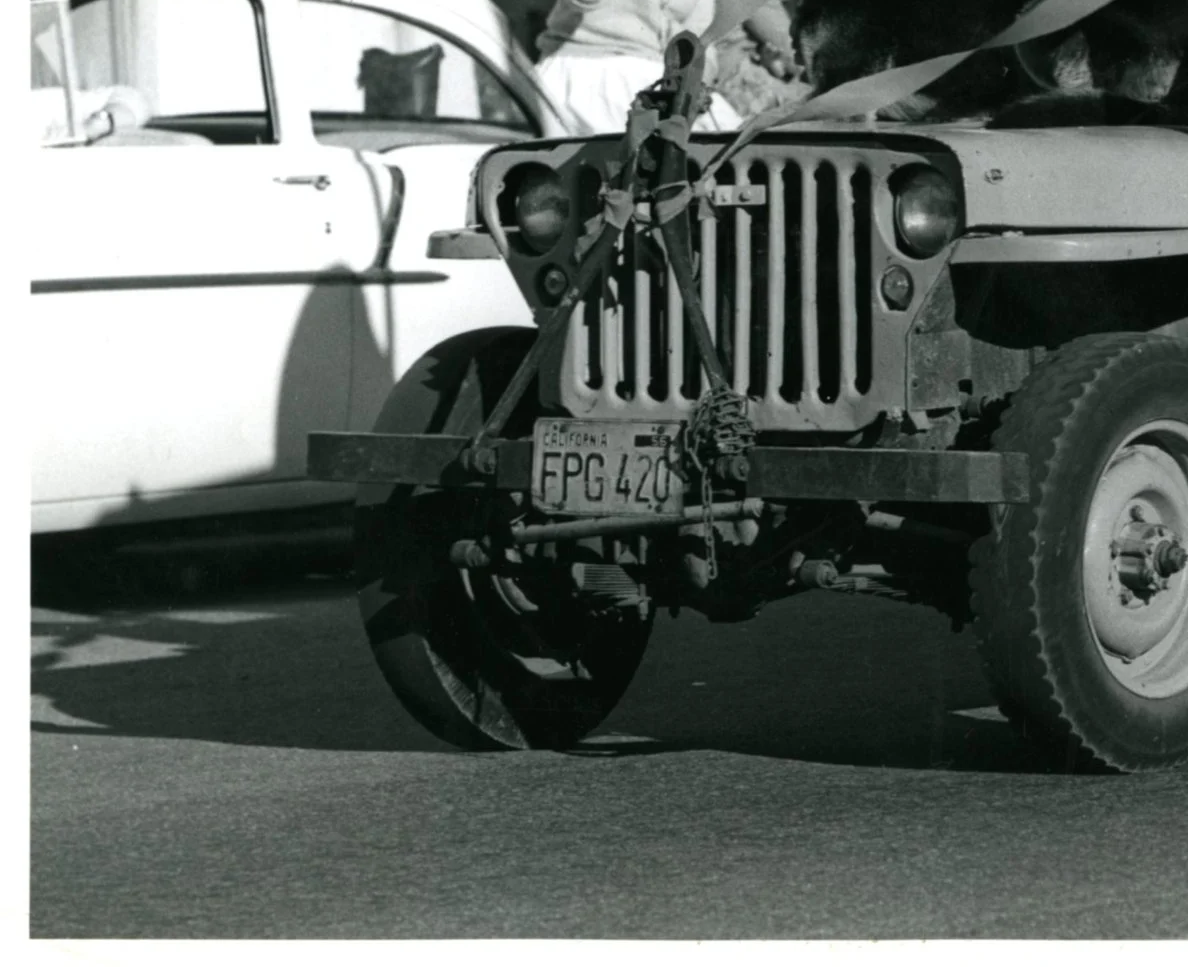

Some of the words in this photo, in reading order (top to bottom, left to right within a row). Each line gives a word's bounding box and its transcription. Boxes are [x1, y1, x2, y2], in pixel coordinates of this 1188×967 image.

[544, 433, 608, 448] CALIFORNIA
[541, 452, 605, 502] FPG
[616, 453, 670, 503] 420
